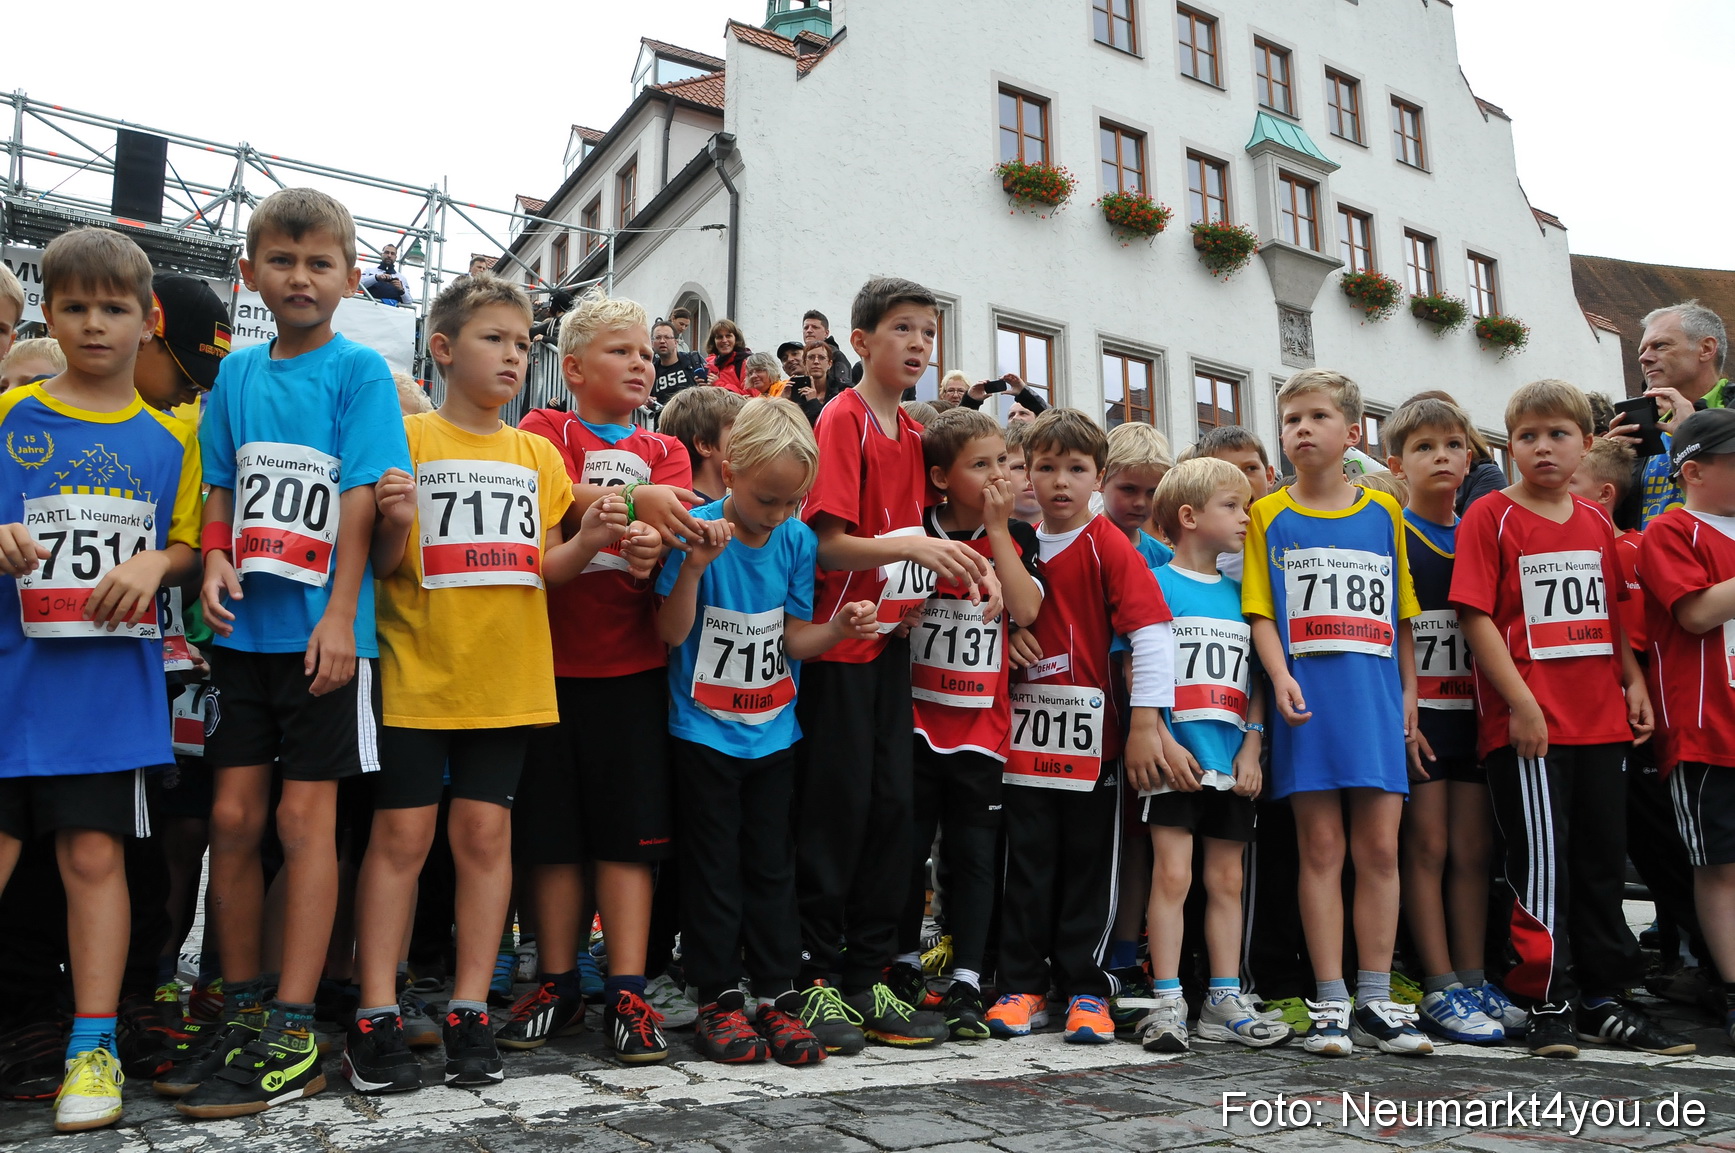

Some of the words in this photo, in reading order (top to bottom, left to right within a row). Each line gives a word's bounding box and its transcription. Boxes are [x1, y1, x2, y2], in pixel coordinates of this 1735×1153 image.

[24, 435, 36, 443] 15
[18, 446, 45, 454] Jahre
[1672, 442, 1701, 465] Sebastian
[256, 454, 325, 477] Neumarkt
[584, 460, 613, 472] PARTL
[420, 472, 465, 486] PARTL
[469, 472, 525, 489] Neumarkt
[26, 508, 76, 525] PARTL
[80, 508, 141, 527] Neumarkt
[431, 490, 536, 539] 7173
[243, 533, 284, 555] Jona
[325, 531, 331, 540] K
[465, 548, 518, 567] Robin
[1287, 558, 1324, 570] PARTL
[1327, 558, 1378, 573] Neumarkt
[1522, 562, 1562, 576] PARTL
[1297, 573, 1385, 616] 7188
[139, 627, 156, 636] 2007
[706, 617, 743, 635] PARTL
[746, 619, 783, 636] Neumarkt
[1305, 621, 1381, 640] Konstantin
[1411, 620, 1443, 631] ARTL
[1567, 625, 1603, 641] Lukas
[922, 621, 997, 667] 7137
[713, 633, 785, 683] 7158
[1180, 642, 1248, 683] 707
[1037, 661, 1057, 674] DEHN
[940, 673, 975, 692] Leon
[1440, 681, 1474, 695] Nikla
[732, 692, 774, 709] Kilian
[1038, 694, 1085, 707] Neumarkt
[1210, 689, 1239, 709] Leon
[1013, 708, 1093, 751] 7015
[1034, 756, 1061, 774] Luis
